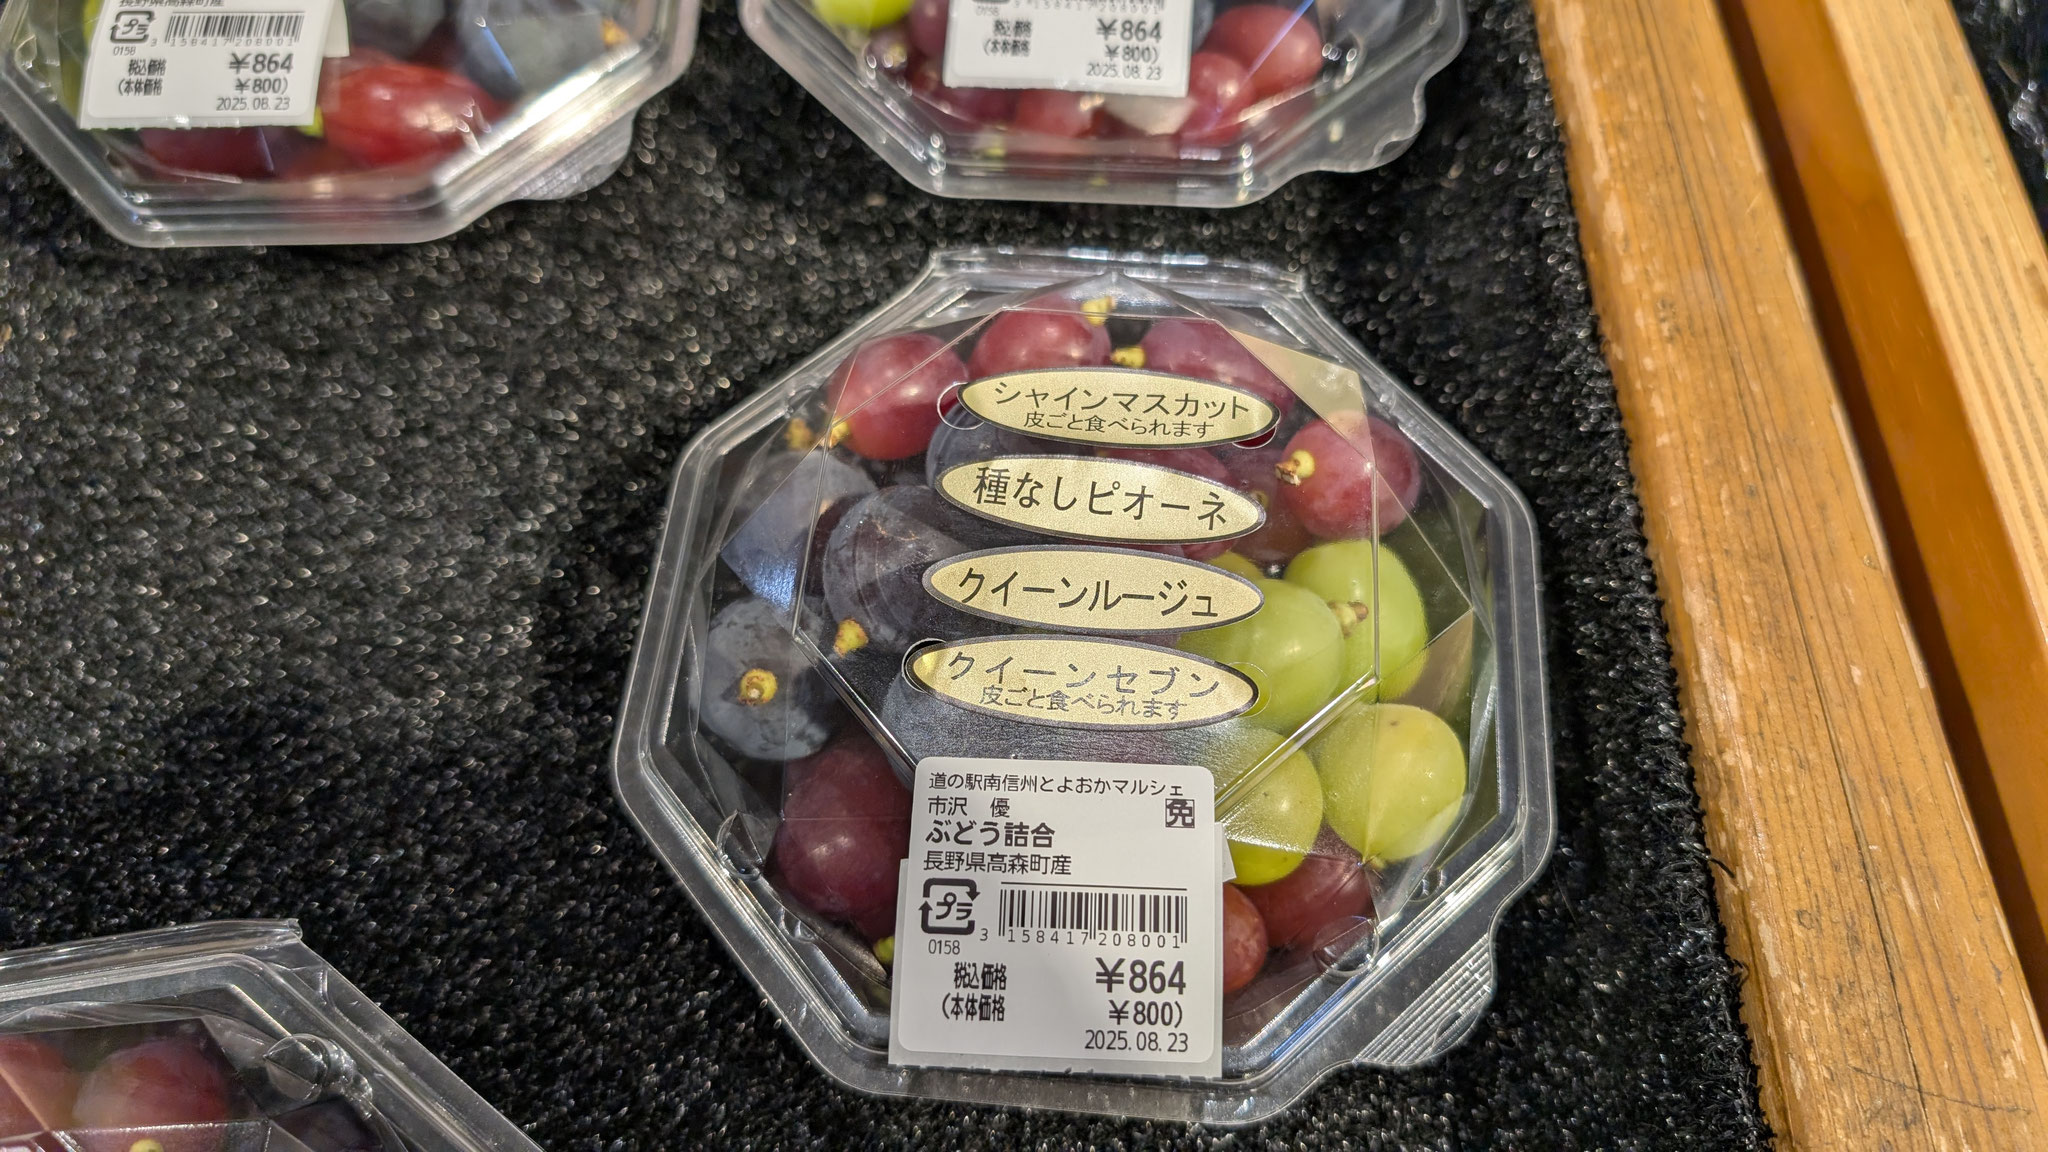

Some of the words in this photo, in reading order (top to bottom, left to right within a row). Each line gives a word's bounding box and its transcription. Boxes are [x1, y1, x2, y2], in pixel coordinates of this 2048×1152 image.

[1096, 19, 1163, 43] ¥864
[112, 46, 137, 56] 0158
[228, 52, 294, 75] ¥864
[1104, 44, 1159, 63] ¥800)
[1086, 63, 1162, 81] 2025.08.23
[235, 77, 289, 95] ¥800)
[215, 96, 291, 111] 2025.08.23
[994, 380, 1250, 421] シャインマスカット
[1022, 410, 1215, 439] 皮ごと食べられます
[972, 465, 1228, 532] 種なしピオーネ
[958, 567, 1219, 617] クイーンルージュ
[948, 651, 1220, 699] クイーンセブン
[978, 685, 1189, 721] 皮ごと食べられます
[928, 771, 1185, 797] 道の駅南信州とよおかマルシェ
[927, 796, 968, 817] 市沢
[990, 797, 1011, 819] 優
[924, 820, 1056, 848] ぶどう詰合
[922, 850, 1073, 876] 長野県高森町産
[935, 891, 973, 921] プラ
[927, 939, 962, 956] 0158
[979, 928, 989, 942] 3
[1007, 929, 1090, 946] 158417
[1098, 932, 1181, 950] 208001
[953, 961, 1008, 991] 税込価格
[1095, 956, 1187, 996] ¥864
[941, 992, 1006, 1022] (本体価格
[1108, 999, 1184, 1029] ¥800)
[1084, 1029, 1190, 1053] 2025.08.23
